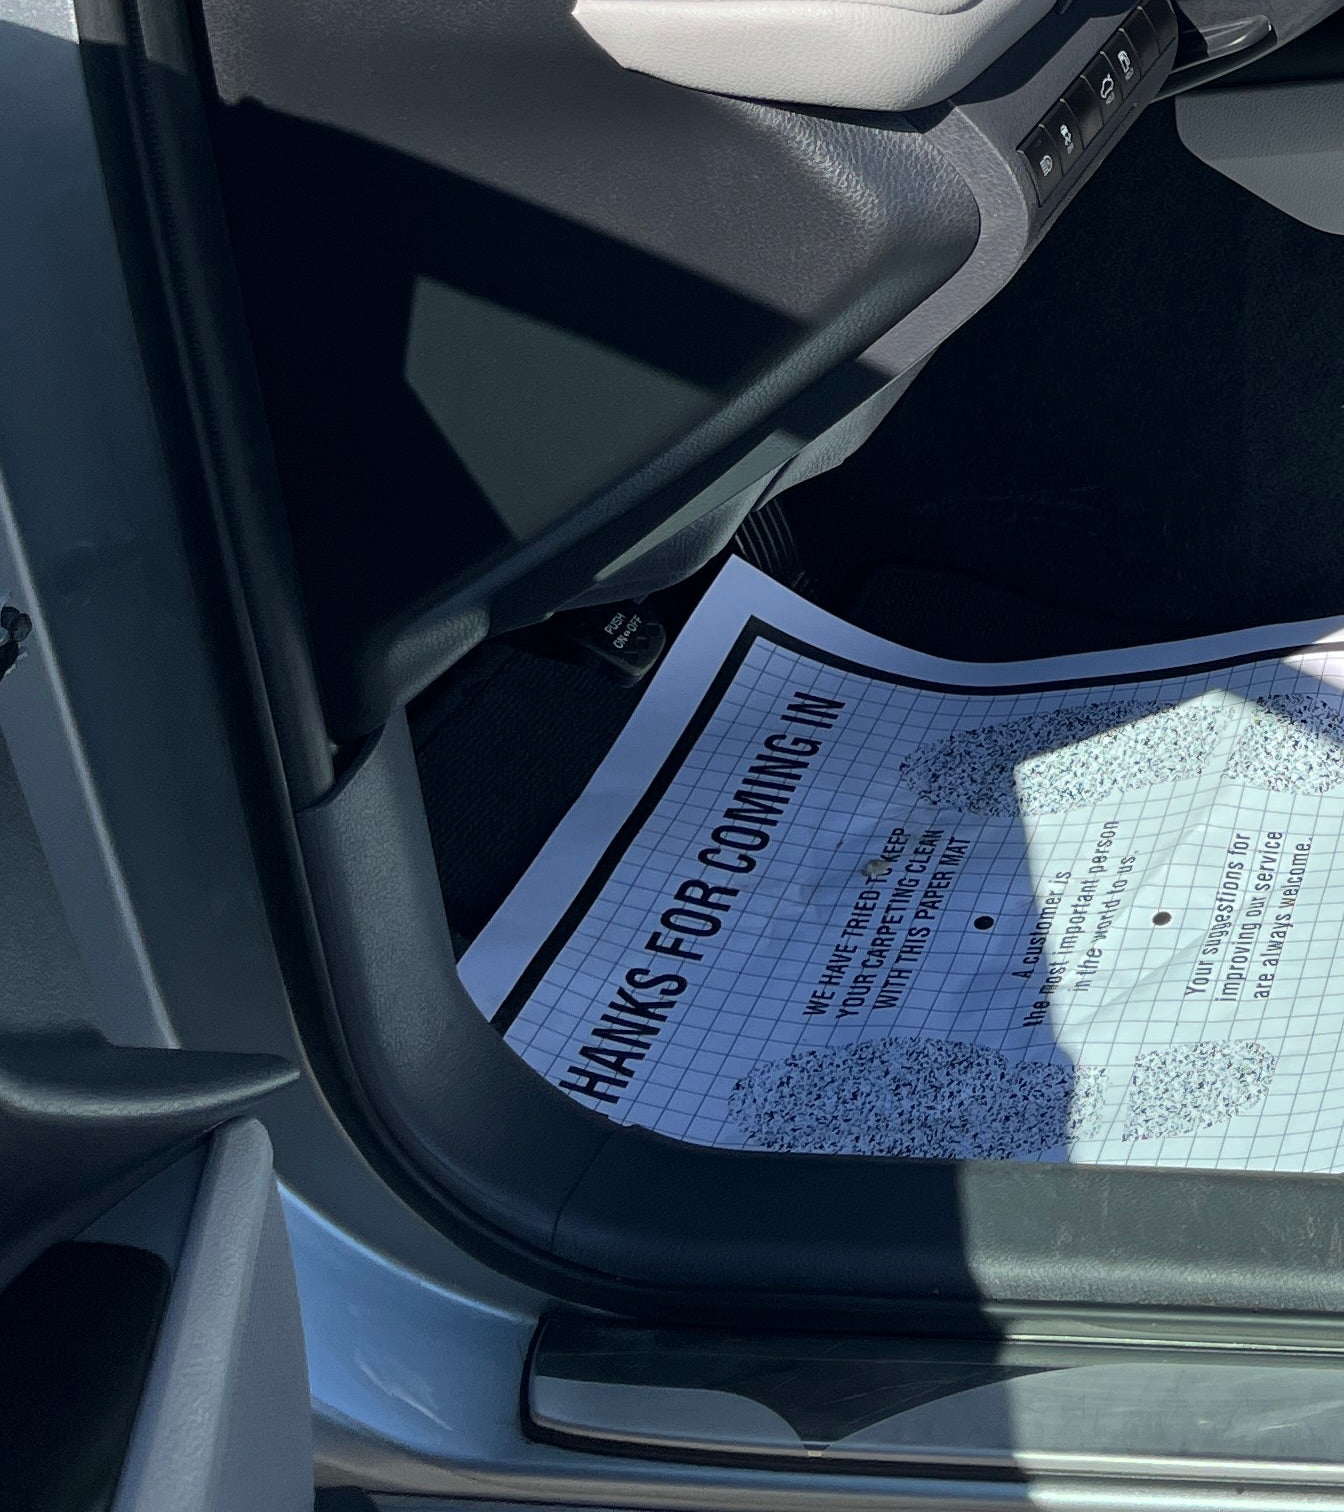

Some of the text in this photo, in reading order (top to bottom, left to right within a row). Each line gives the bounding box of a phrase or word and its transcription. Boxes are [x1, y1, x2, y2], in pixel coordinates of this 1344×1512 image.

[604, 612, 626, 635] PUSH
[880, 827, 911, 863] KEEP
[559, 691, 846, 1114] HANKS FOR COMING IN
[1106, 879, 1128, 895] to
[835, 830, 944, 1018] YOUR CARPETING CLEAN
[841, 890, 880, 938] TRIED
[872, 837, 971, 1009] WITH THIS PAPER MAT
[1012, 871, 1072, 979] A customer is
[1023, 821, 1120, 1028] the most important person
[1093, 898, 1121, 944] world
[1184, 833, 1251, 996] Your suggestions for
[1215, 831, 1283, 1001] improving our service
[1253, 837, 1313, 999] are always welcome.
[818, 944, 857, 986] HAVE
[1067, 980, 1092, 992] in
[1076, 948, 1103, 977] the
[802, 990, 835, 1016] WE
